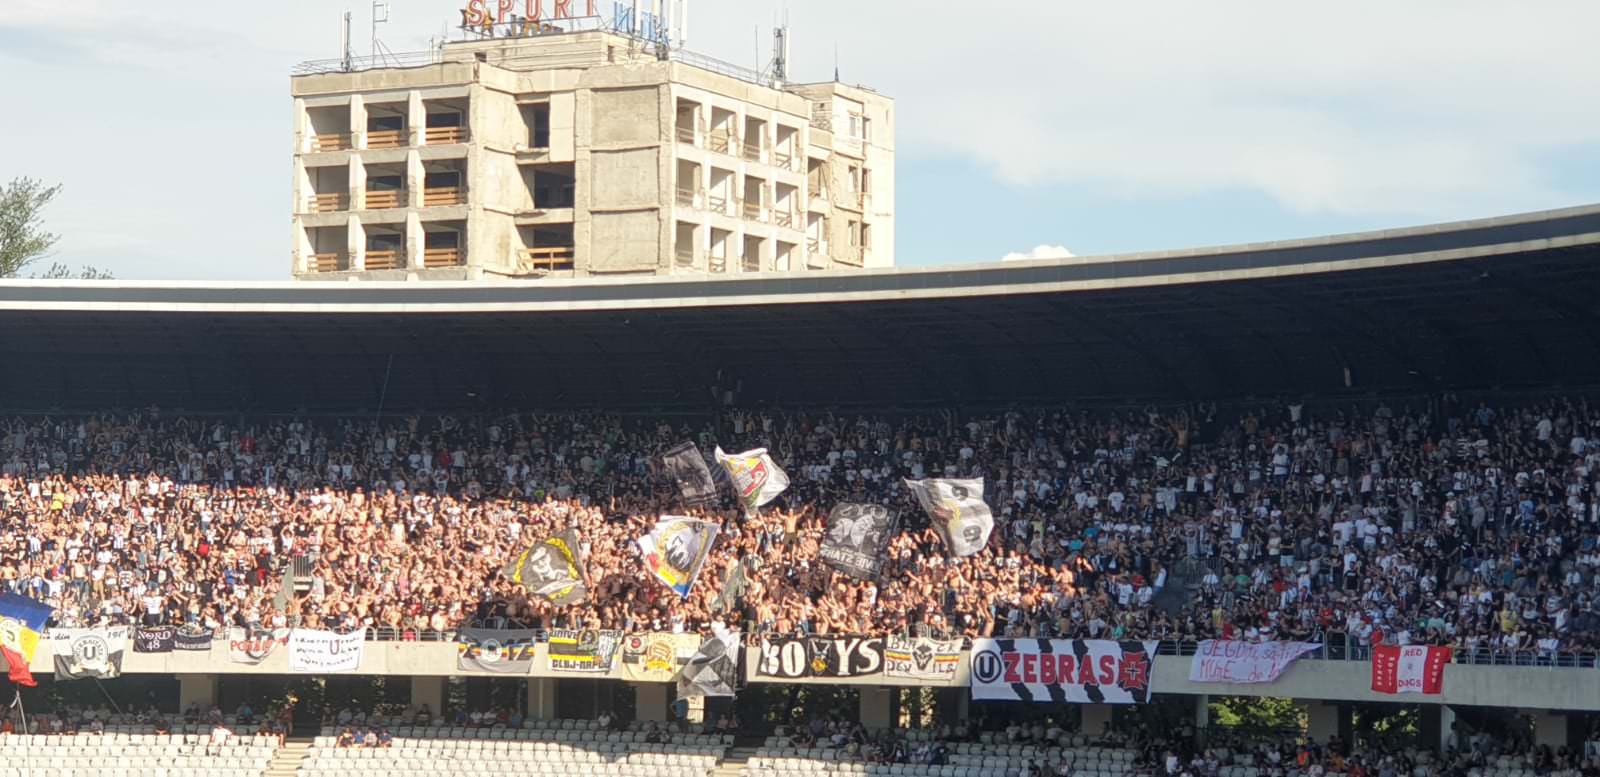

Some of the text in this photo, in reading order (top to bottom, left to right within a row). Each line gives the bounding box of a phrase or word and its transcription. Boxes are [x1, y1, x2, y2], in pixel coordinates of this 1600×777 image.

[138, 630, 172, 640] NORD
[147, 640, 160, 651] 48
[83, 646, 97, 661] U
[1404, 648, 1423, 657] RED
[979, 652, 1115, 685] U ZEBRAS
[1398, 678, 1422, 688] DOGS
